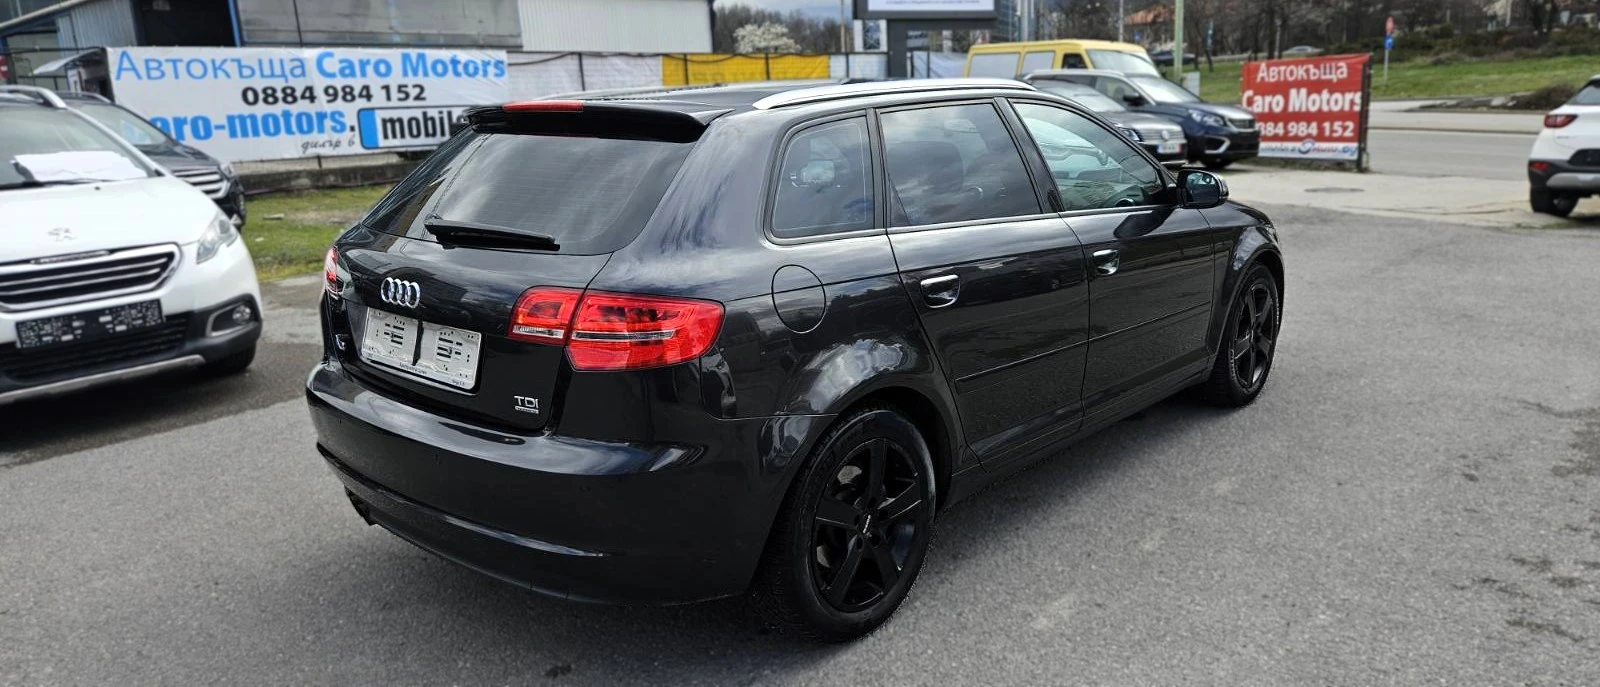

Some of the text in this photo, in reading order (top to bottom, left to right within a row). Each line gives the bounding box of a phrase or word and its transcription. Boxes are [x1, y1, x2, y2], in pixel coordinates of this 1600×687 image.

[115, 50, 507, 83] Автокъща Caro Motors
[1256, 61, 1348, 83] Автокъща
[241, 83, 427, 106] 0884 984 152
[1242, 88, 1362, 113] Caro Motors
[148, 109, 355, 142] aro-motors.
[1287, 121, 1319, 137] 984
[1322, 121, 1354, 138] 152
[513, 395, 539, 409] TDI
